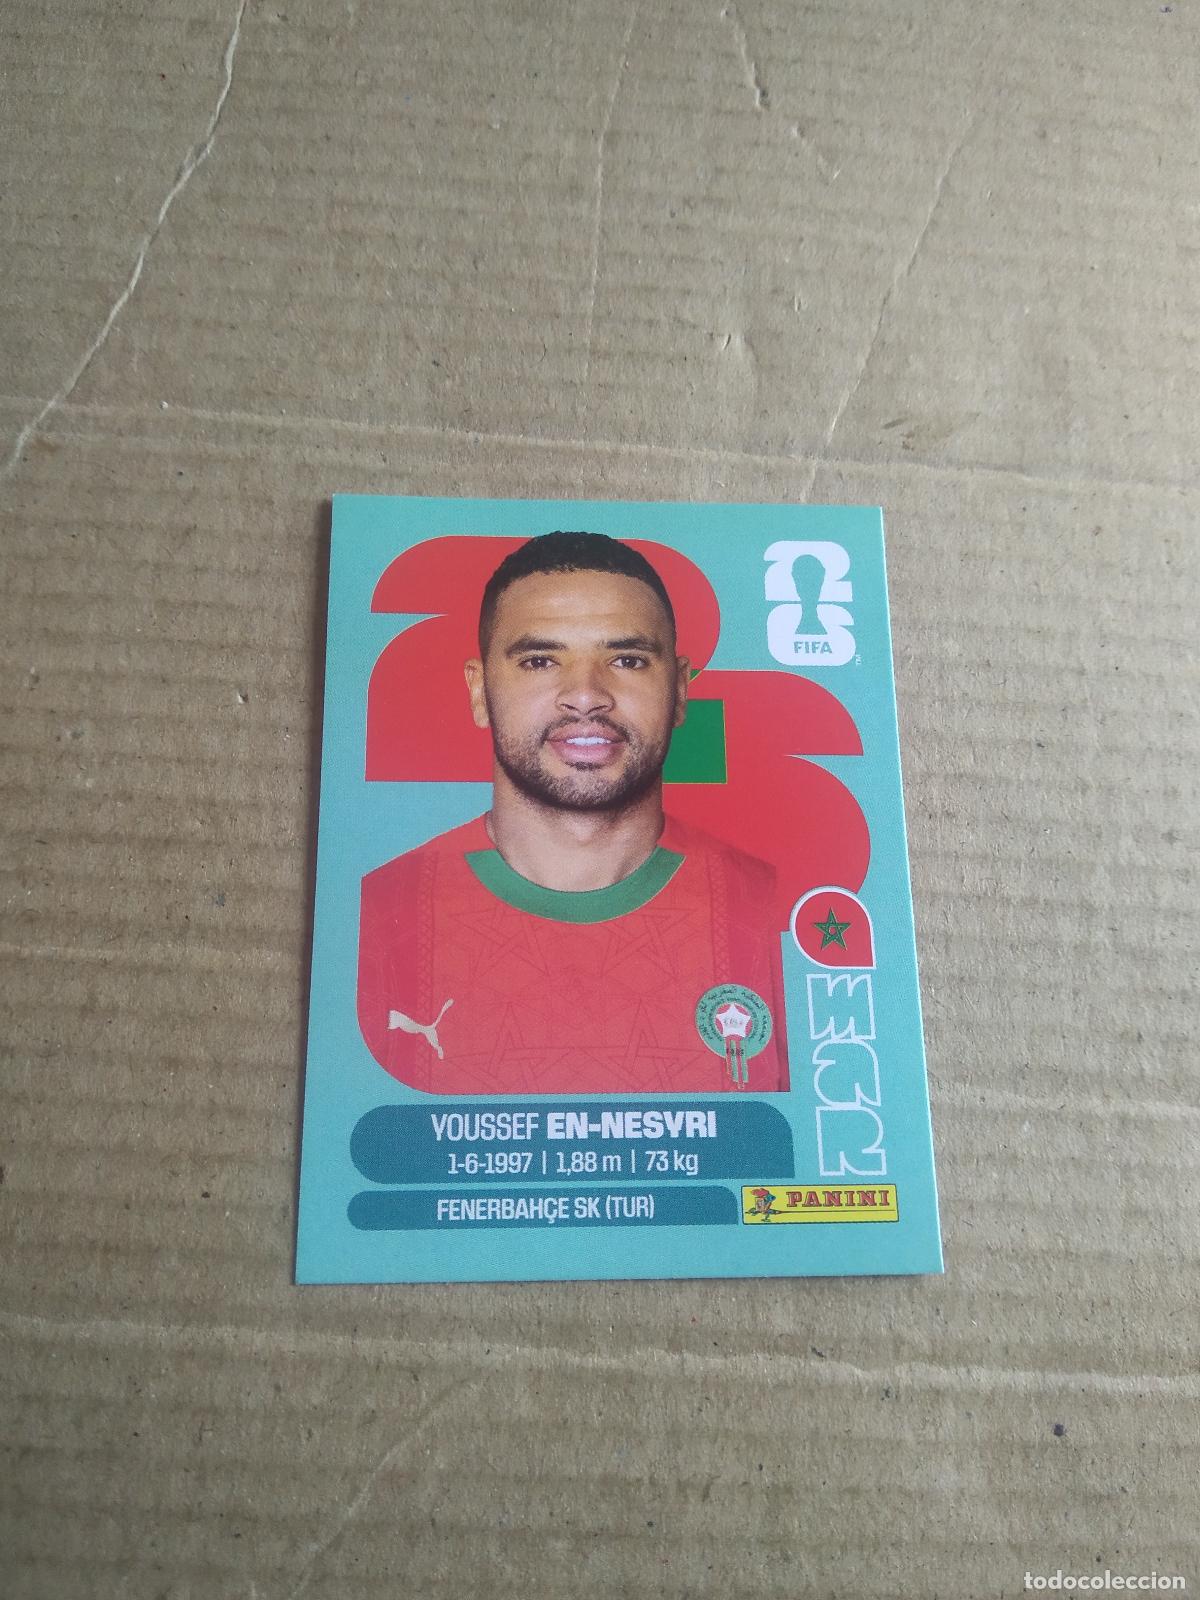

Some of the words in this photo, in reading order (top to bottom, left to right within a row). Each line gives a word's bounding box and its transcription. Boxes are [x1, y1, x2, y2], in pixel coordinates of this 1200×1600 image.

[793, 641, 833, 654] FIFA
[431, 1112, 539, 1141] YOUSSEF
[547, 1110, 717, 1140] EN-NESYRI
[447, 1152, 533, 1175] 1-6-1997
[556, 1151, 597, 1176] 1,88
[602, 1153, 622, 1173] m
[645, 1150, 669, 1172] 73
[673, 1149, 699, 1176] kg
[437, 1197, 570, 1223] FENERBAHÇE
[574, 1196, 601, 1218] SK
[605, 1194, 655, 1220] (TUR)
[785, 1190, 891, 1208] PANINI
